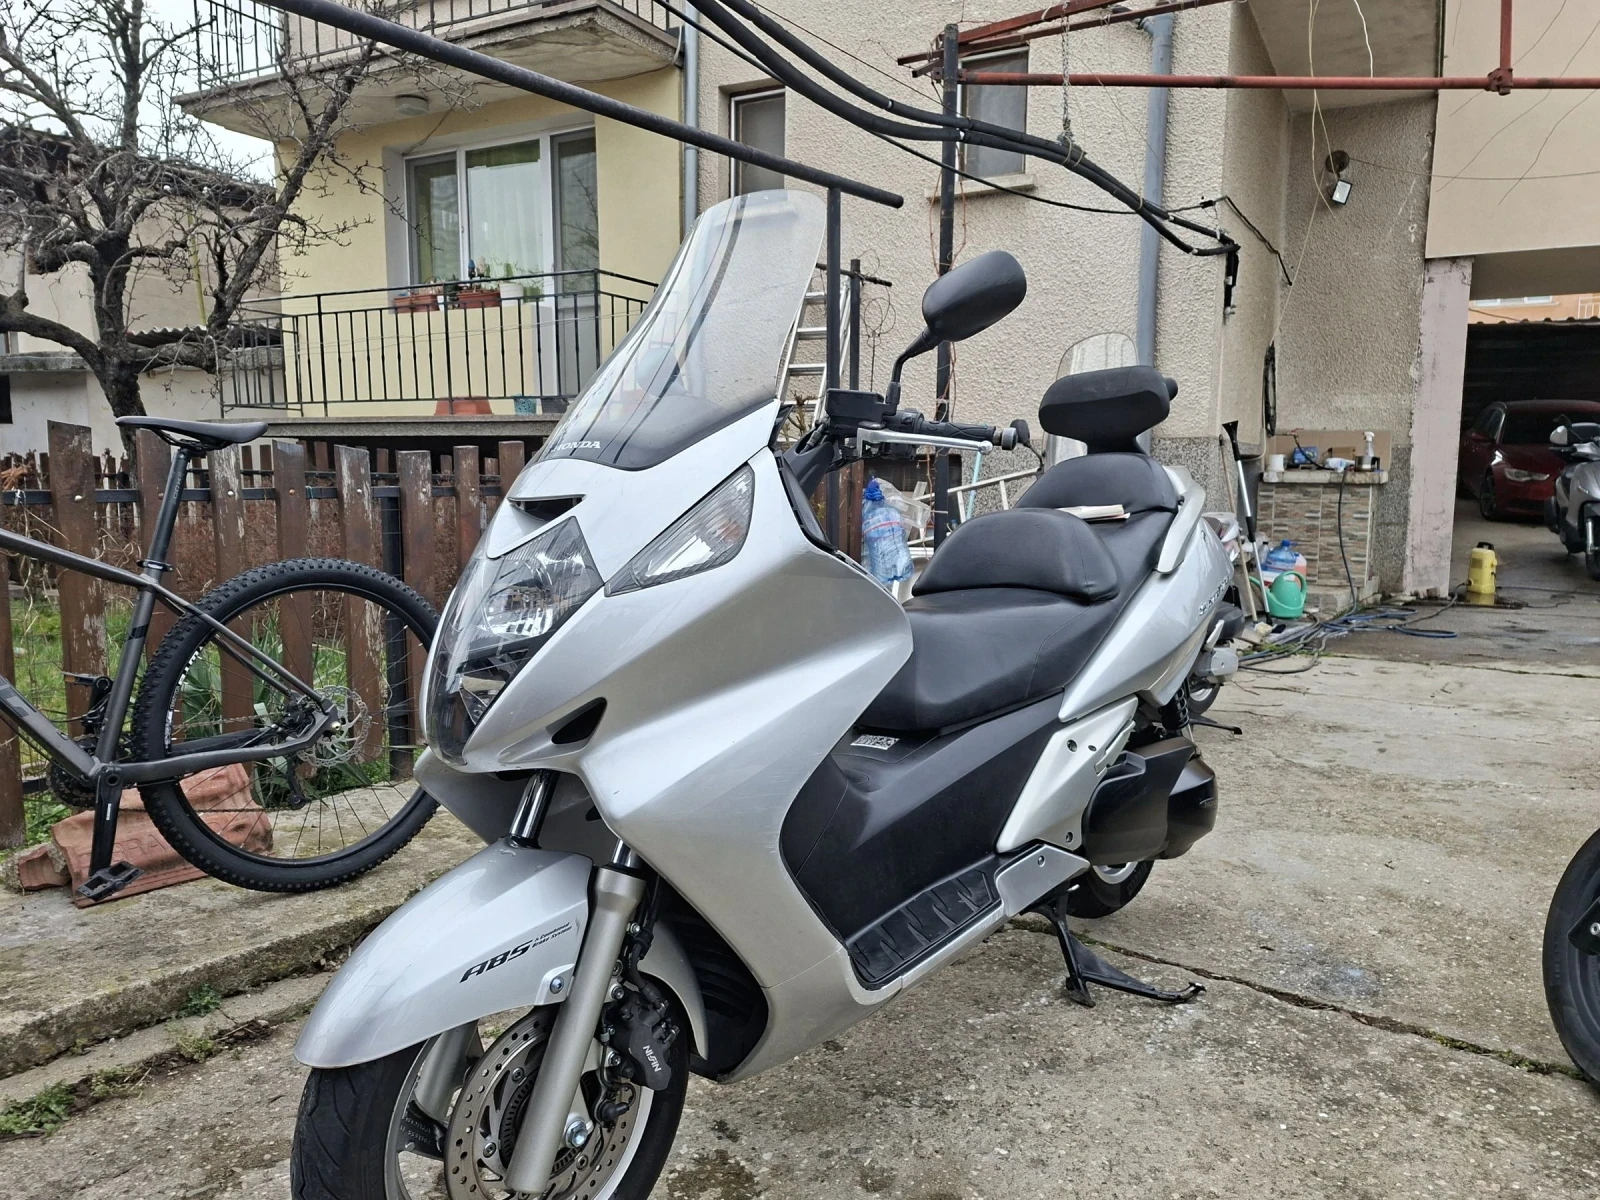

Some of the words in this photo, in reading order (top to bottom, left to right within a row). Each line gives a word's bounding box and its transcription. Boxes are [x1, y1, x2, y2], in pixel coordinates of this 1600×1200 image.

[551, 440, 601, 452] HONDA
[459, 939, 533, 983] ABS
[642, 1045, 662, 1072] NISSIN
